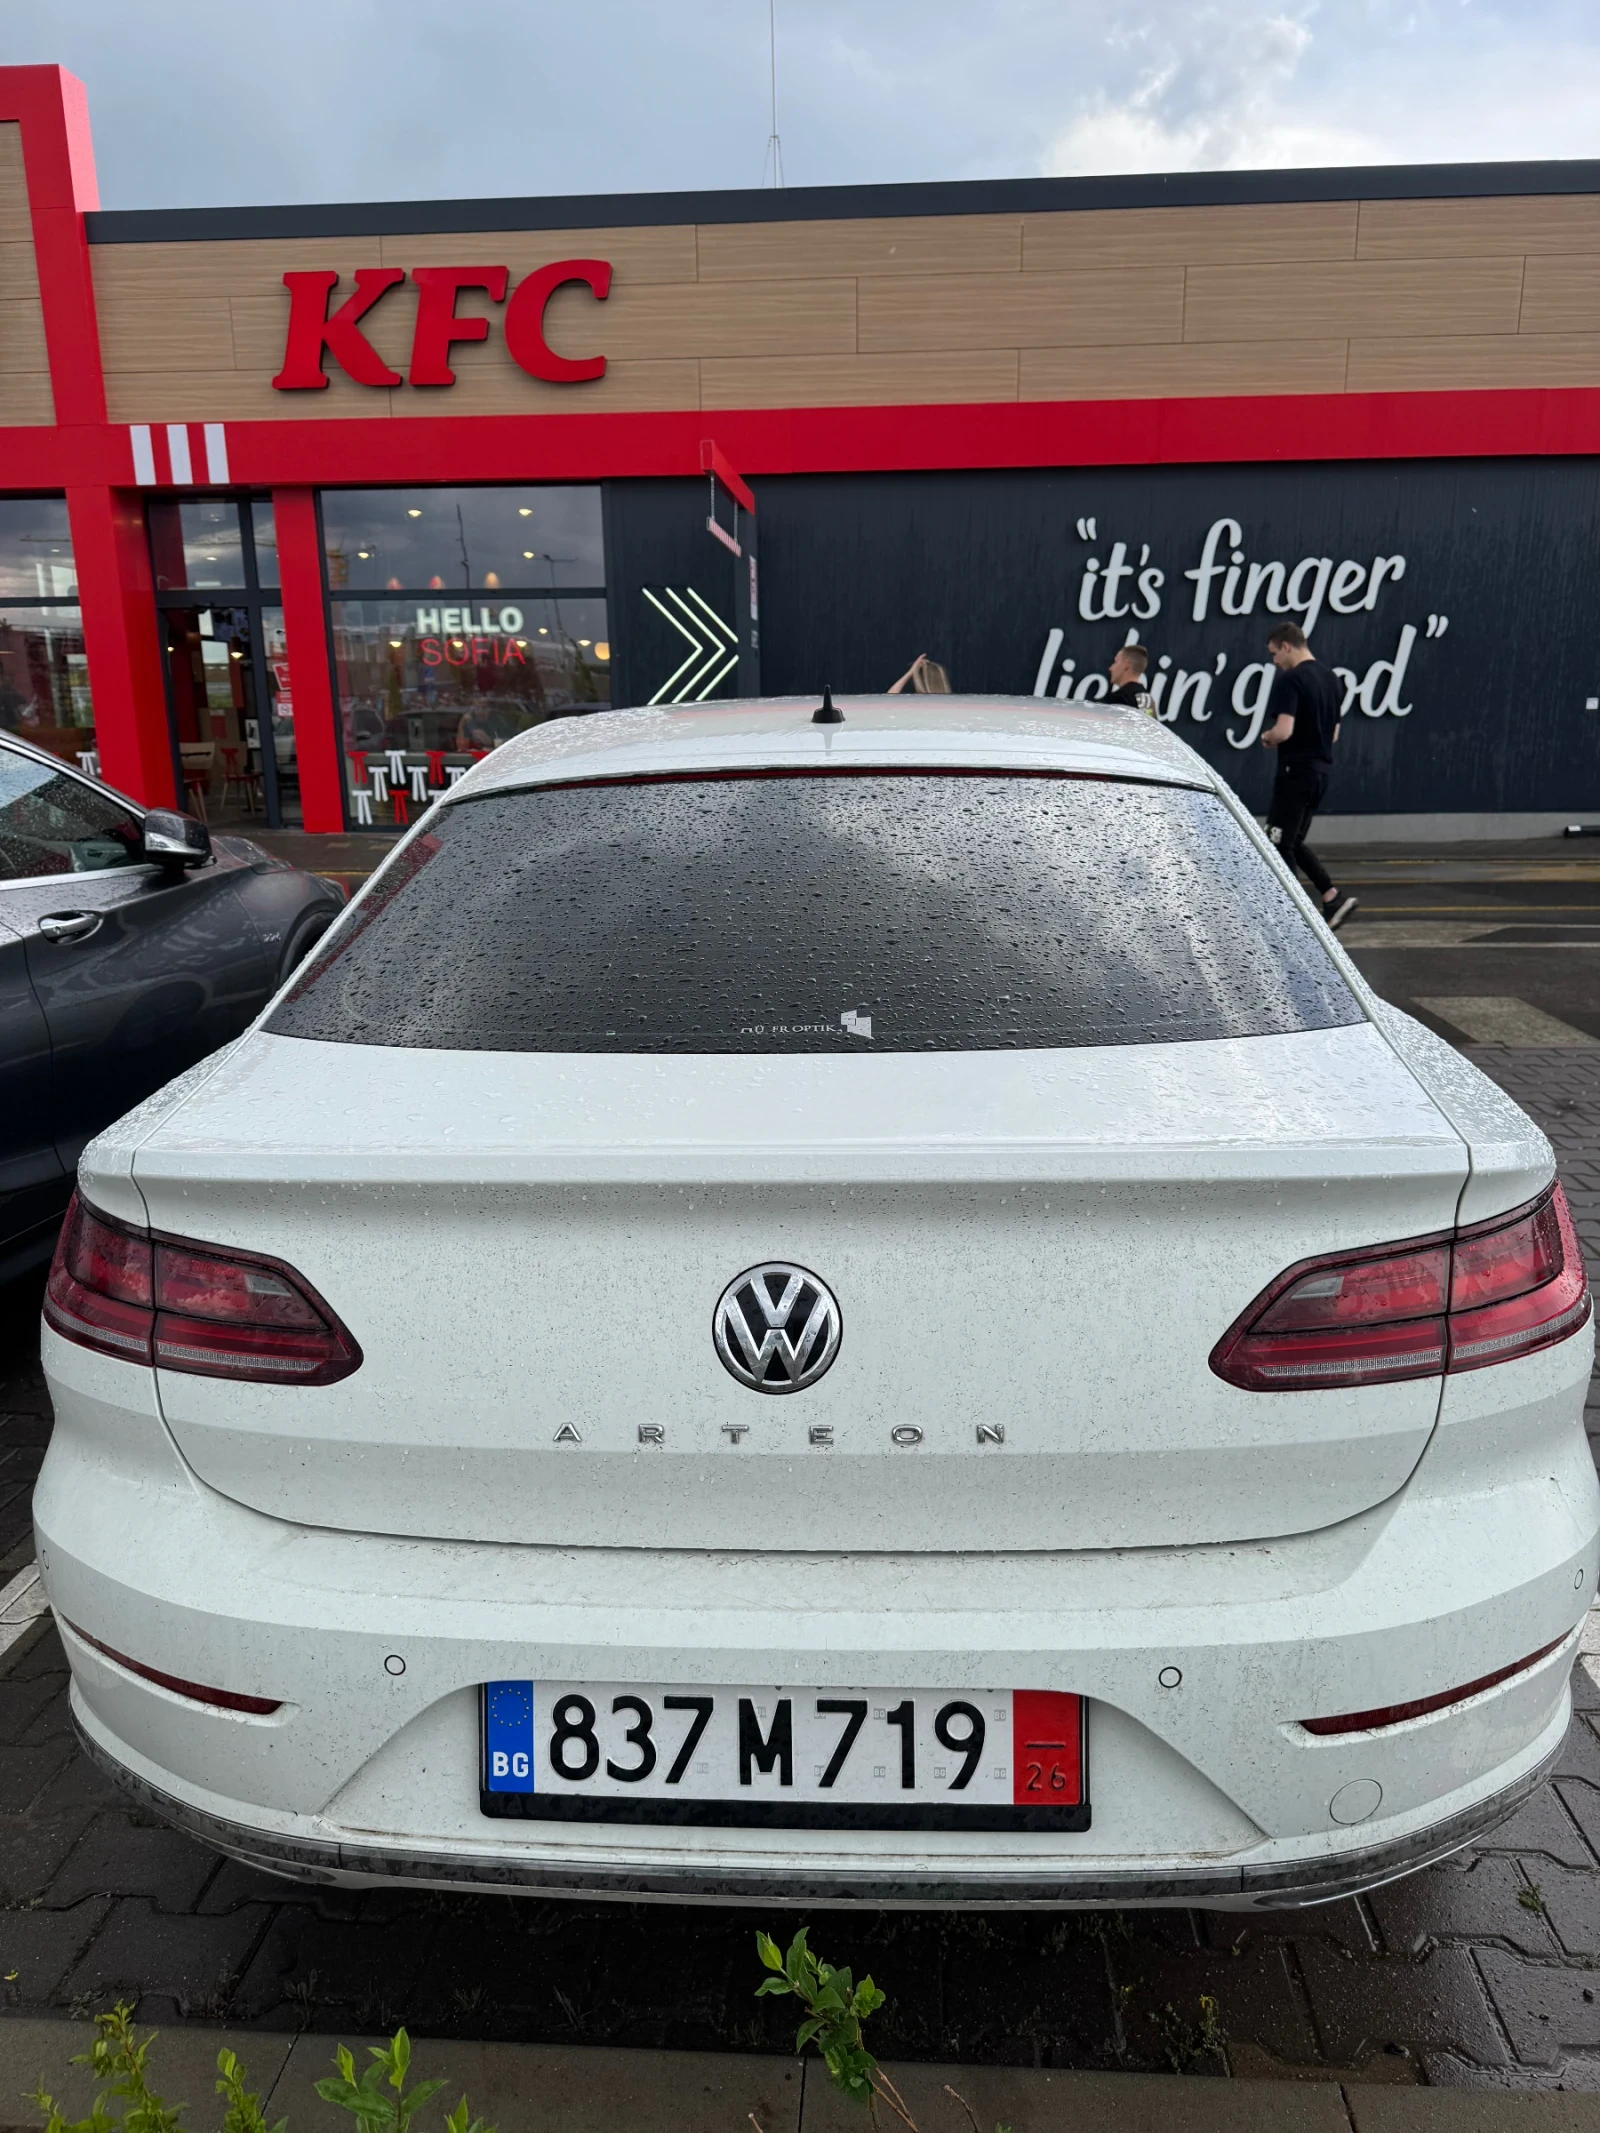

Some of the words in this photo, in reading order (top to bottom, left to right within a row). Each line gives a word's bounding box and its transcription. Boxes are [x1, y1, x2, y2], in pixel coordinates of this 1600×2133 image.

[272, 259, 612, 390] KFC
[416, 606, 524, 634] HELLO
[1184, 518, 1406, 639] finger
[420, 637, 527, 666] SOFIA
[718, 1267, 836, 1388] VW
[553, 1422, 1004, 1445] ARTEON
[493, 1751, 529, 1778] BG
[550, 1694, 714, 1784] 837
[739, 1698, 793, 1786] M
[817, 1699, 985, 1790] 719
[1027, 1763, 1066, 1791] 26
